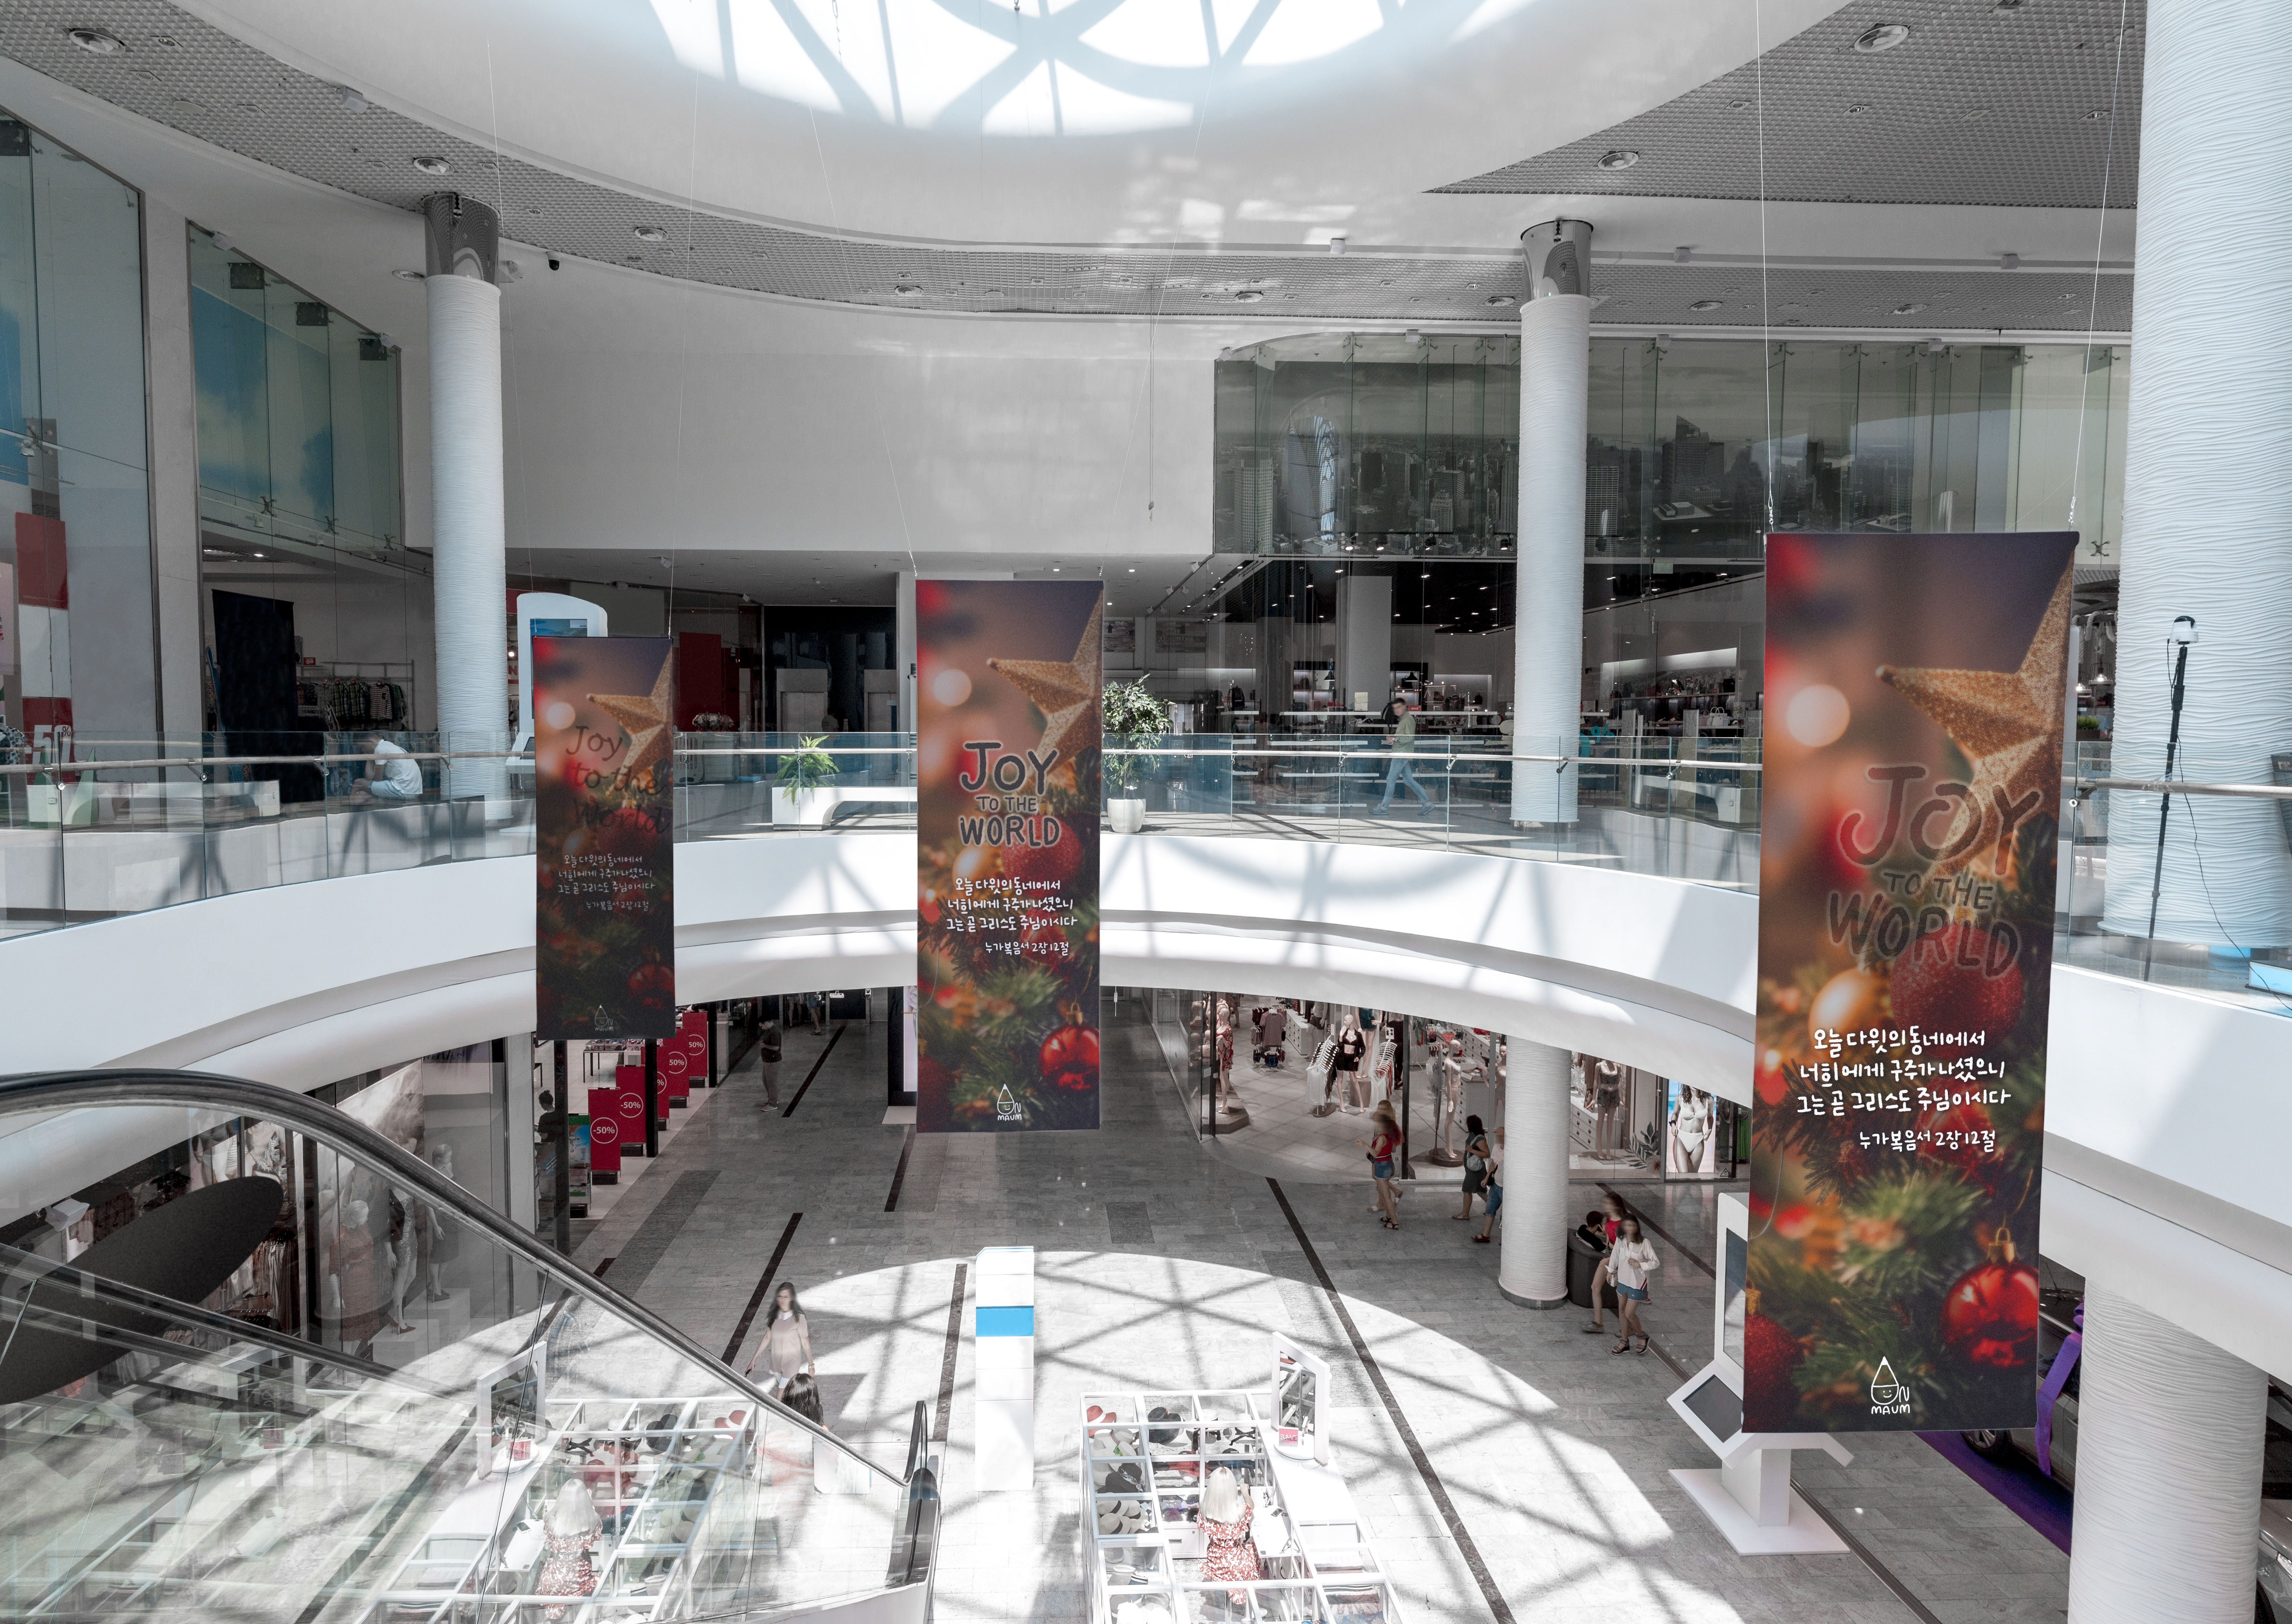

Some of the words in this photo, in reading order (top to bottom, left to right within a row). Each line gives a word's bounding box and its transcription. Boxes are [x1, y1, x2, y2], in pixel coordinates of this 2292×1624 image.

[566, 726, 623, 761] Joy
[571, 763, 609, 788] to
[610, 765, 667, 796] the
[961, 742, 1058, 795] JOY
[573, 795, 671, 834] World
[976, 796, 999, 811] TO
[1005, 797, 1037, 812] THE
[960, 816, 1059, 847] WORLD
[1840, 766, 2040, 875] JOY
[955, 878, 973, 896] 오늘
[976, 878, 1012, 894] 다윗의
[1014, 877, 1060, 895] 동네에서
[1883, 872, 1921, 895] TO
[1934, 876, 1993, 910] THE
[948, 899, 999, 914] 너희에게
[1004, 898, 1031, 911] 구주가
[1033, 898, 1072, 912] 나셨으니
[947, 919, 964, 931] 그는
[967, 916, 976, 932] 곧
[980, 917, 1016, 930] 그리스도
[1020, 915, 1077, 930] 주님이시다
[1830, 893, 2018, 978] WORLD
[986, 942, 1028, 955] 누가복음서
[1032, 943, 1047, 954] 2장
[1050, 942, 1068, 955] 12절
[1814, 1028, 1843, 1057] 오늘
[1847, 1029, 1905, 1053] 다윗의
[1910, 1026, 1985, 1054] 동네에서
[1801, 1062, 1884, 1087] 너희에게
[1891, 1060, 1935, 1082] 구주가
[1939, 1057, 2004, 1082] 나셨으니
[1797, 1095, 1825, 1115] 그는
[1831, 1091, 1845, 1116] 곧
[1852, 1090, 1911, 1112] 그리스도
[1918, 1088, 2011, 1111] 주님이시다
[1860, 1130, 1930, 1151] 누가복음서
[1935, 1131, 1959, 1150] 2장
[1965, 1130, 1995, 1152] 12절
[1871, 1404, 1910, 1415] MAUM
